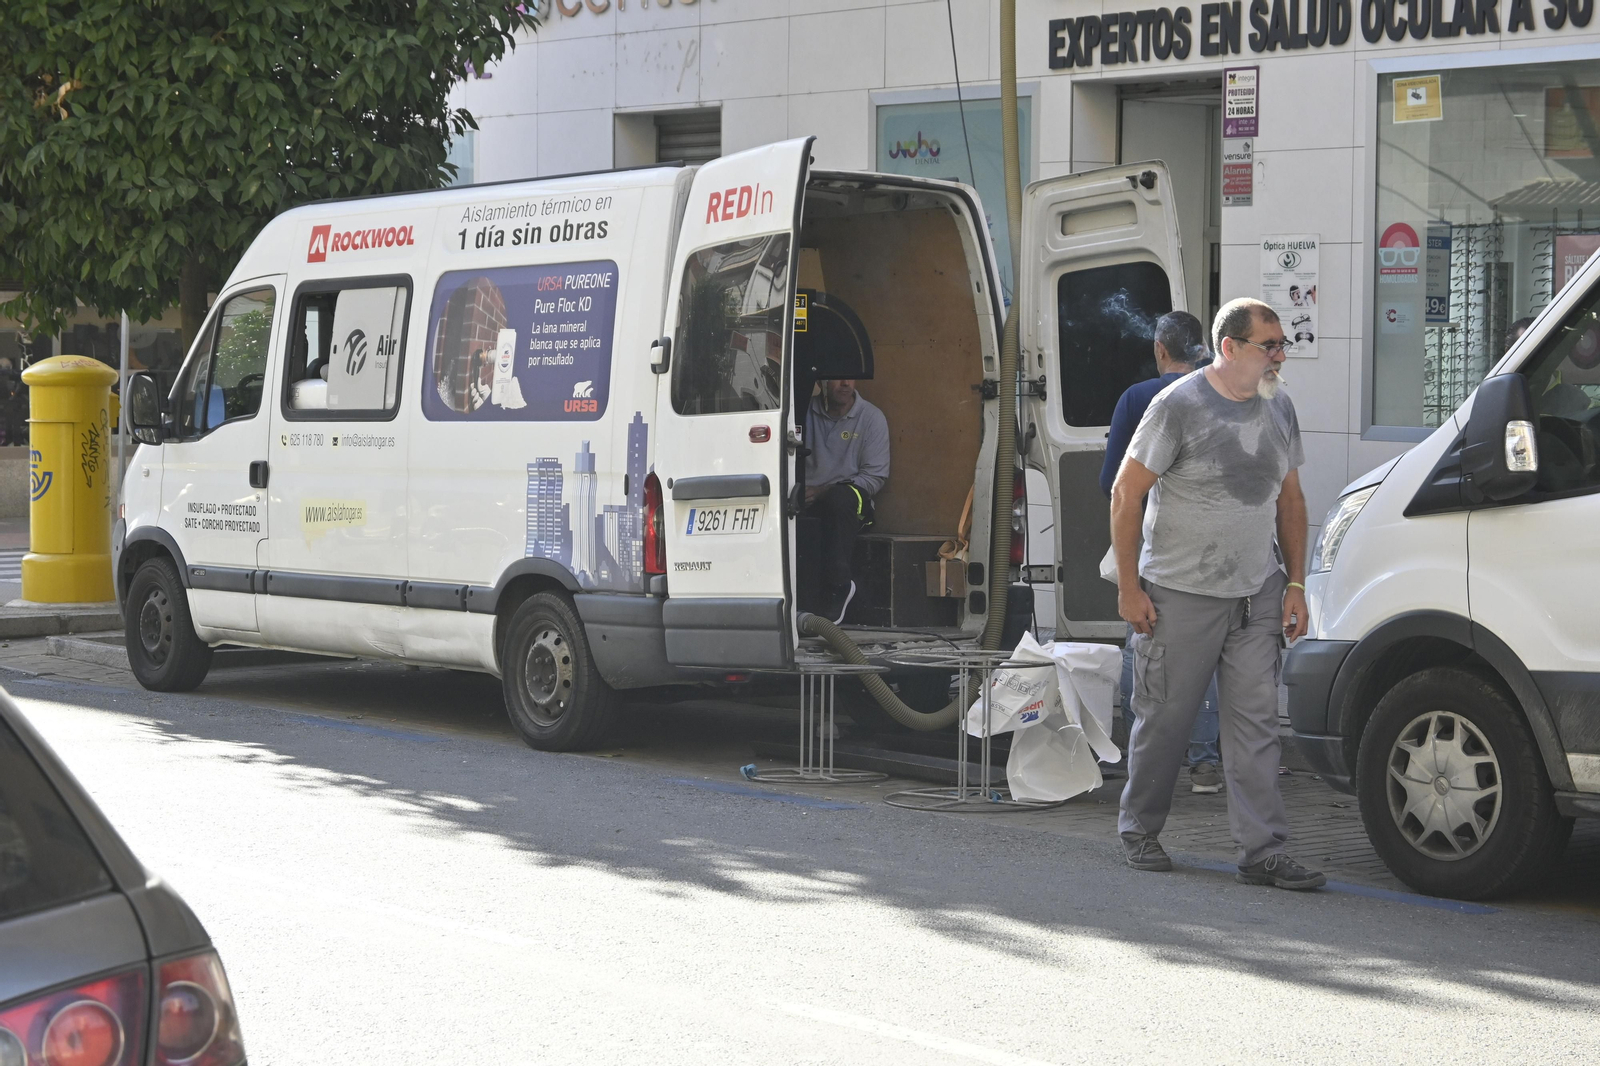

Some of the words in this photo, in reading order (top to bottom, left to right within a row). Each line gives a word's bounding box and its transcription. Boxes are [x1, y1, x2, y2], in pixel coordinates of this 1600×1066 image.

[1049, 6, 1192, 69] EXPERTOS
[1200, 1, 1241, 56] EN
[1248, 0, 1351, 53] SALUD
[1361, 0, 1501, 44] OCULAR
[1508, 0, 1536, 32] A
[1228, 88, 1255, 96] PROTEGIDO
[1228, 107, 1235, 115] 24
[1236, 106, 1254, 115] HORAS
[1224, 167, 1251, 175] Alarma
[461, 204, 536, 223] Aislamiento
[541, 199, 590, 217] térmico
[595, 196, 613, 210] en
[331, 225, 414, 252] ROCKWOOL
[458, 228, 466, 250] 1
[475, 223, 504, 249] día
[512, 222, 541, 246] sin
[550, 218, 608, 243] obras
[1264, 240, 1285, 251] Óptica
[1288, 241, 1316, 250] HUELVA
[537, 276, 562, 291] URSA
[565, 272, 612, 290] PUREONE
[534, 299, 554, 314] Pure
[557, 297, 575, 312] Floc
[578, 296, 592, 312] KD
[532, 322, 541, 333] La
[542, 321, 557, 333] lana
[559, 320, 586, 333] mineral
[530, 338, 552, 350] blanca
[555, 340, 567, 350] que
[570, 339, 577, 348] se
[580, 336, 600, 350] aplica
[528, 355, 540, 368] por
[542, 354, 574, 366] insuflado
[188, 502, 216, 514] INSUFLADO
[221, 504, 257, 516] PROYECTADO
[306, 503, 362, 523] www.aislahogar.es
[184, 518, 197, 528] SATE
[202, 519, 223, 530] CORCHO
[225, 520, 260, 532] PROYECTADO
[697, 509, 728, 531] 9261
[732, 508, 759, 530] FHT
[674, 561, 712, 571] RENAULT
